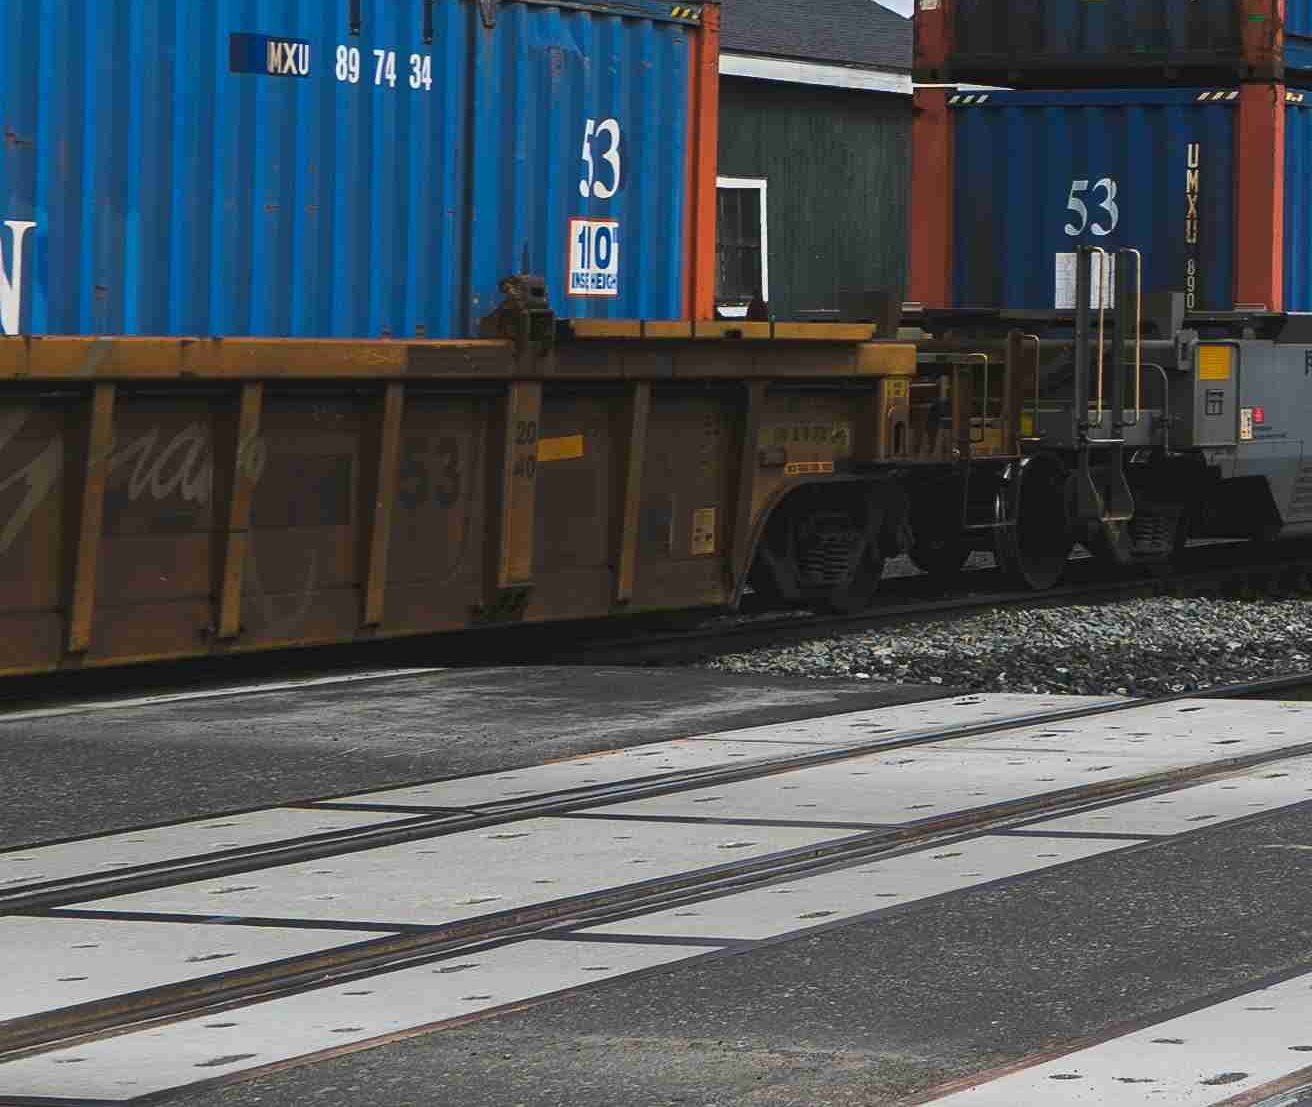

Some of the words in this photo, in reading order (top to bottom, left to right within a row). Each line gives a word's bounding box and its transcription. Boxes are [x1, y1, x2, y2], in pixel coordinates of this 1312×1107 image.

[335, 45, 360, 84] 89
[372, 49, 397, 87] 74
[409, 53, 433, 91] 34
[579, 118, 621, 199] 53
[1064, 177, 1119, 236] 53
[1186, 143, 1199, 243] UMXU
[578, 225, 612, 270] 10
[516, 421, 537, 445] 20
